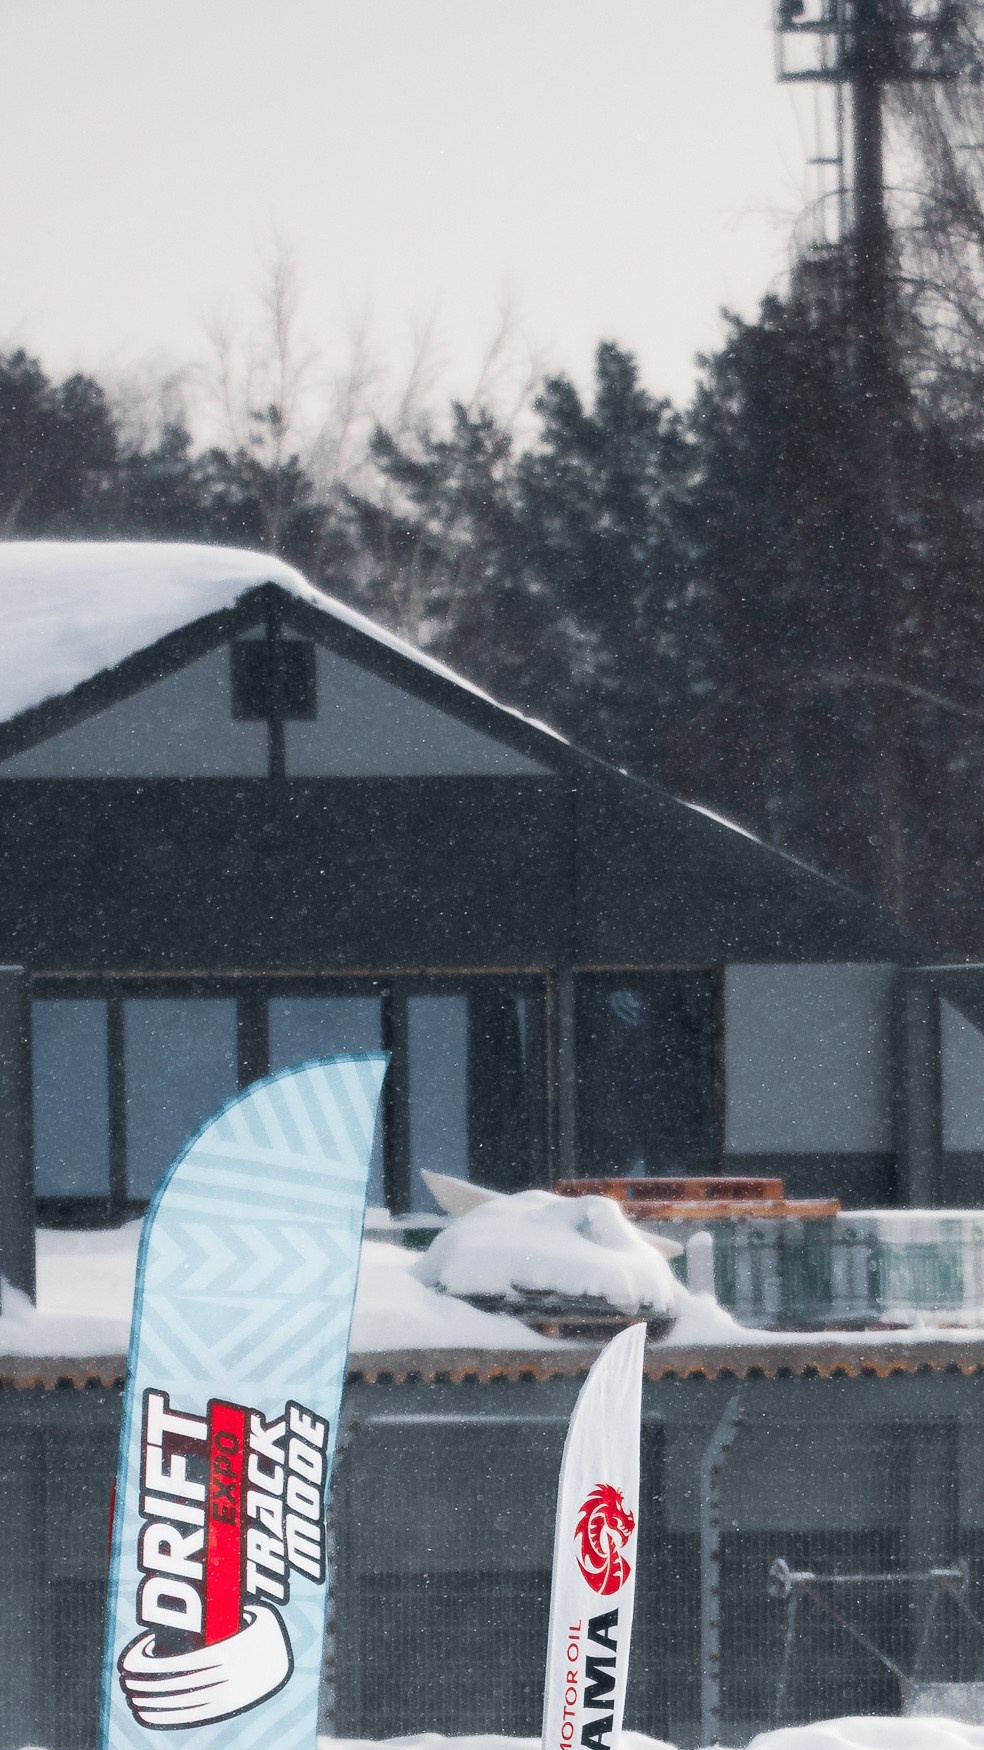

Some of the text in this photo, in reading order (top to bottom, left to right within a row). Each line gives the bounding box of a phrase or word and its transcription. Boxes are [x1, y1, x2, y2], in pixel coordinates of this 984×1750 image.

[139, 1391, 209, 1634] DRIFT
[213, 1430, 239, 1525] EXPO
[246, 1412, 287, 1600] TRACK
[285, 1405, 325, 1580] MODE
[567, 1619, 582, 1662] OIL
